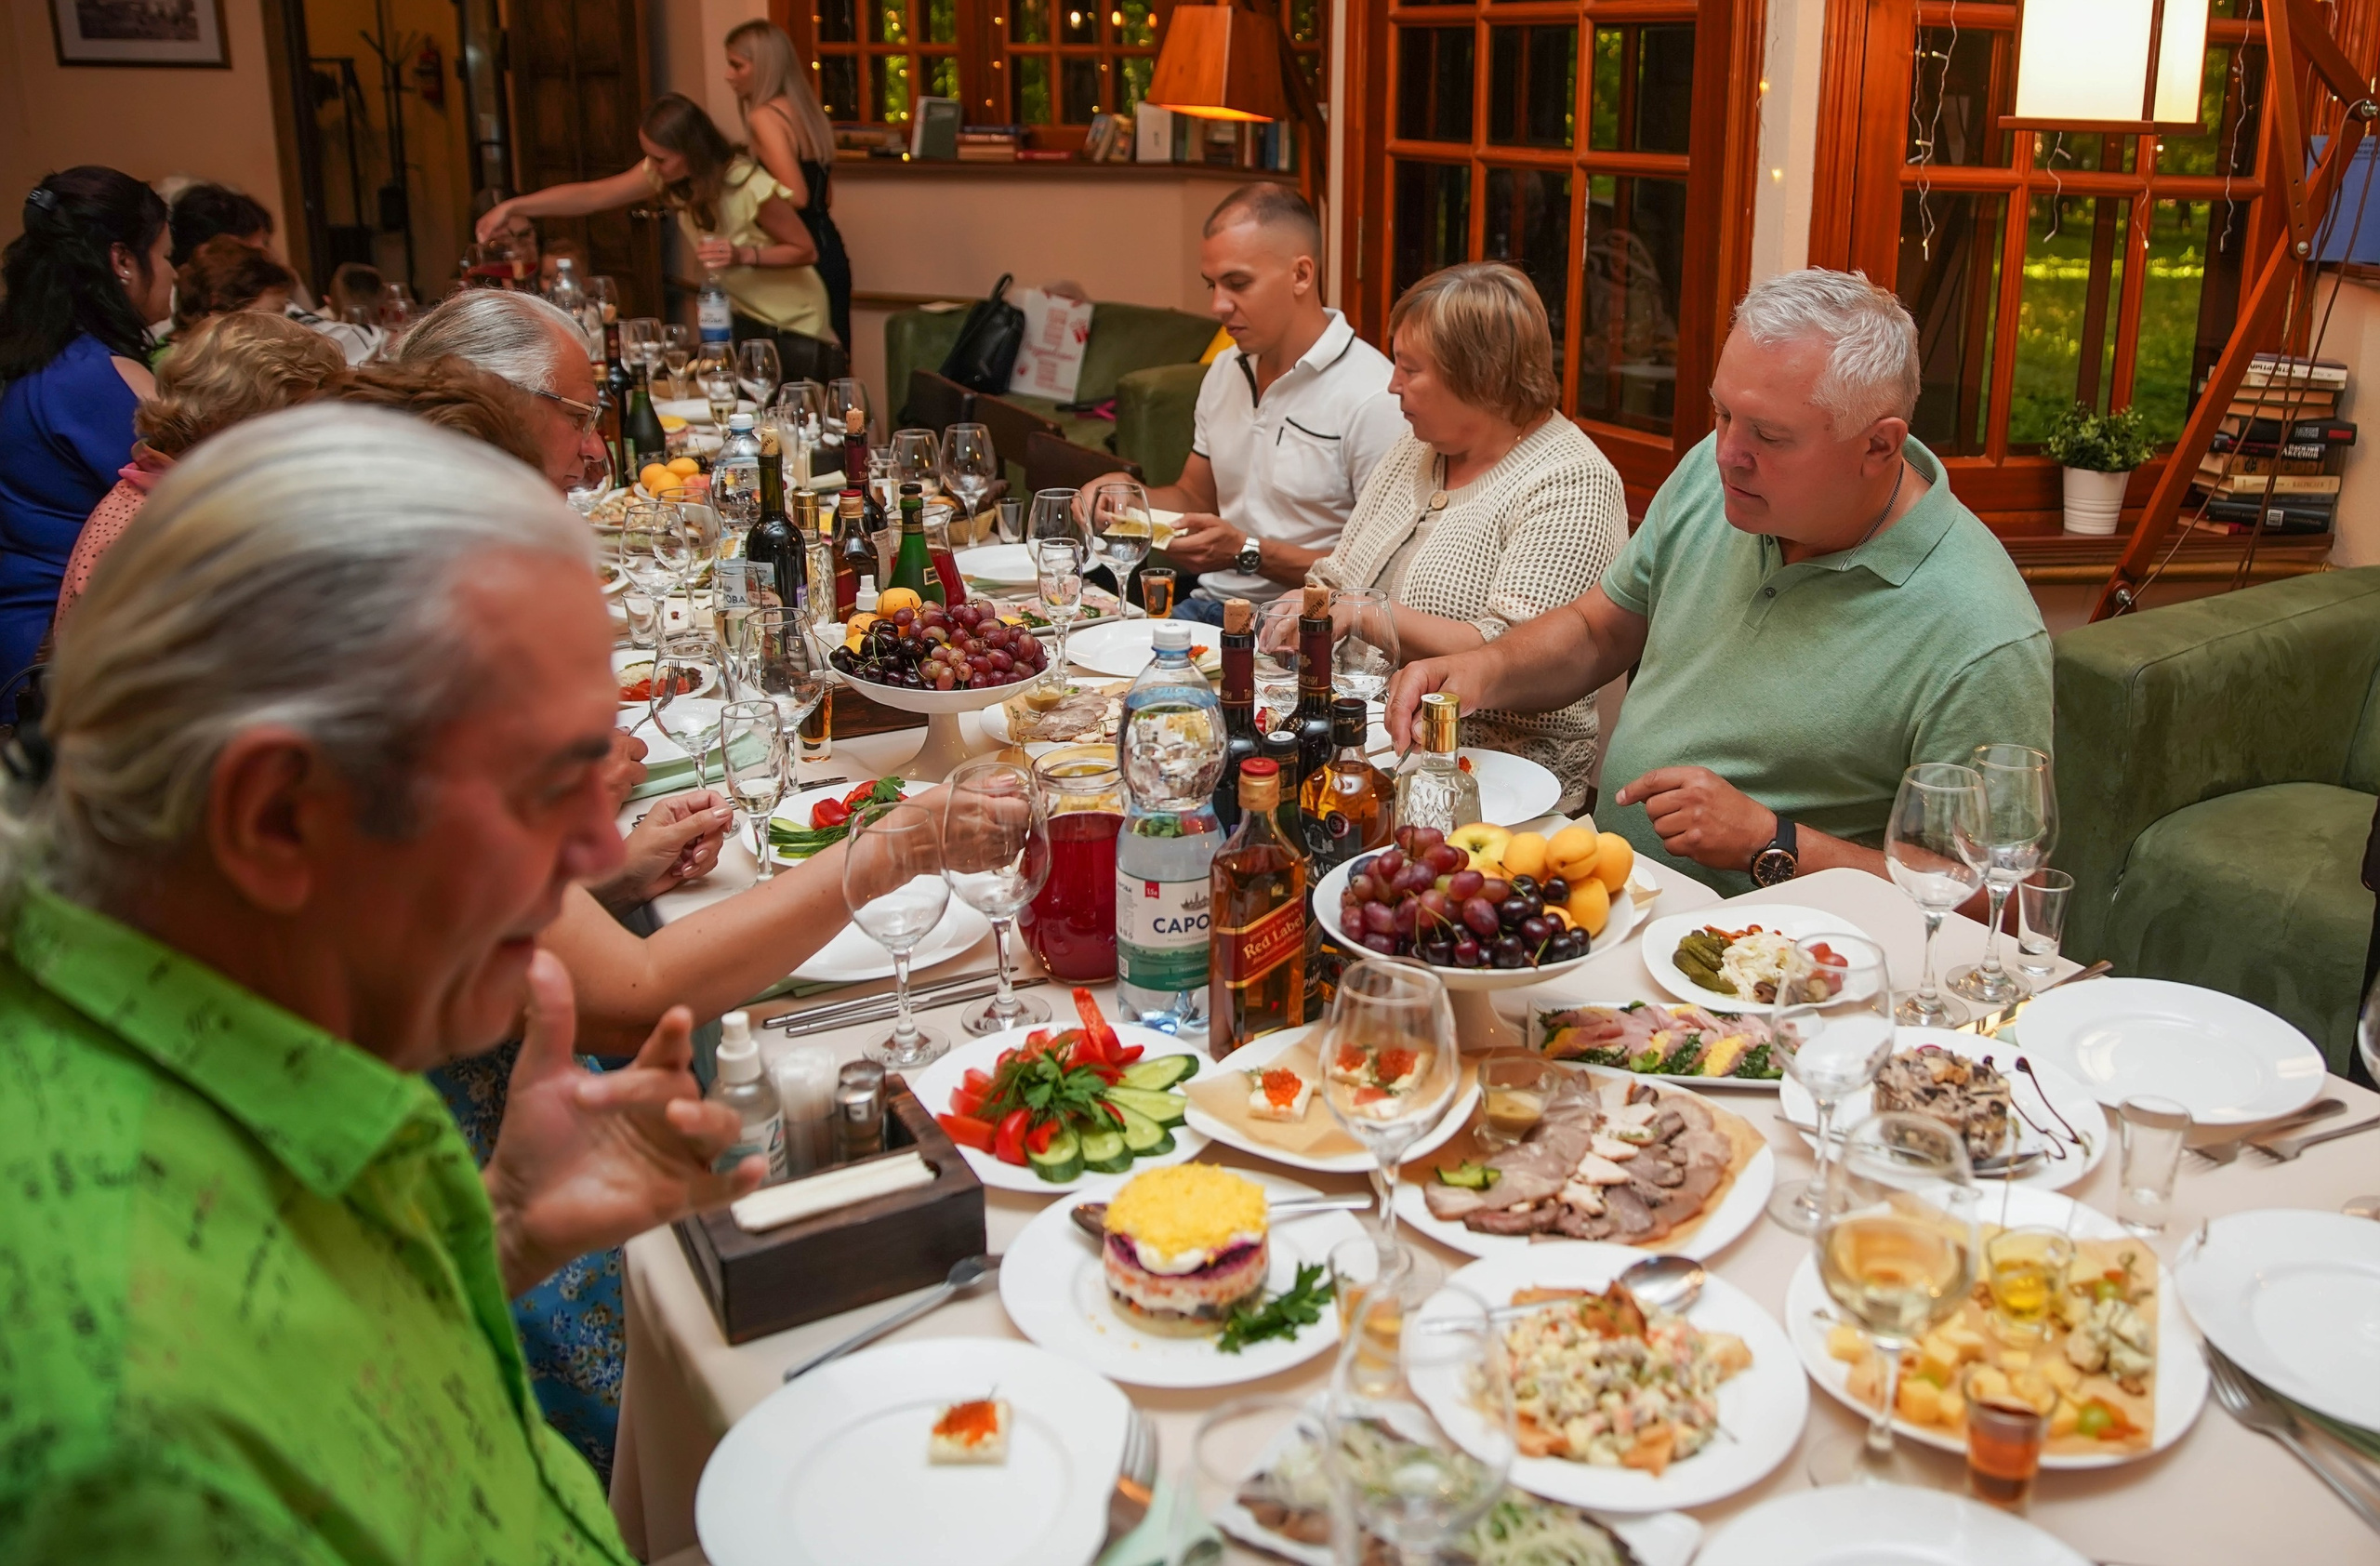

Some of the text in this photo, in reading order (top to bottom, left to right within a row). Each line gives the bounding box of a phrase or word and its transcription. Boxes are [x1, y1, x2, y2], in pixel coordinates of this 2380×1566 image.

[1153, 913, 1210, 934] САРО
[1243, 935, 1271, 959] Red
[1271, 912, 1305, 942] Label
